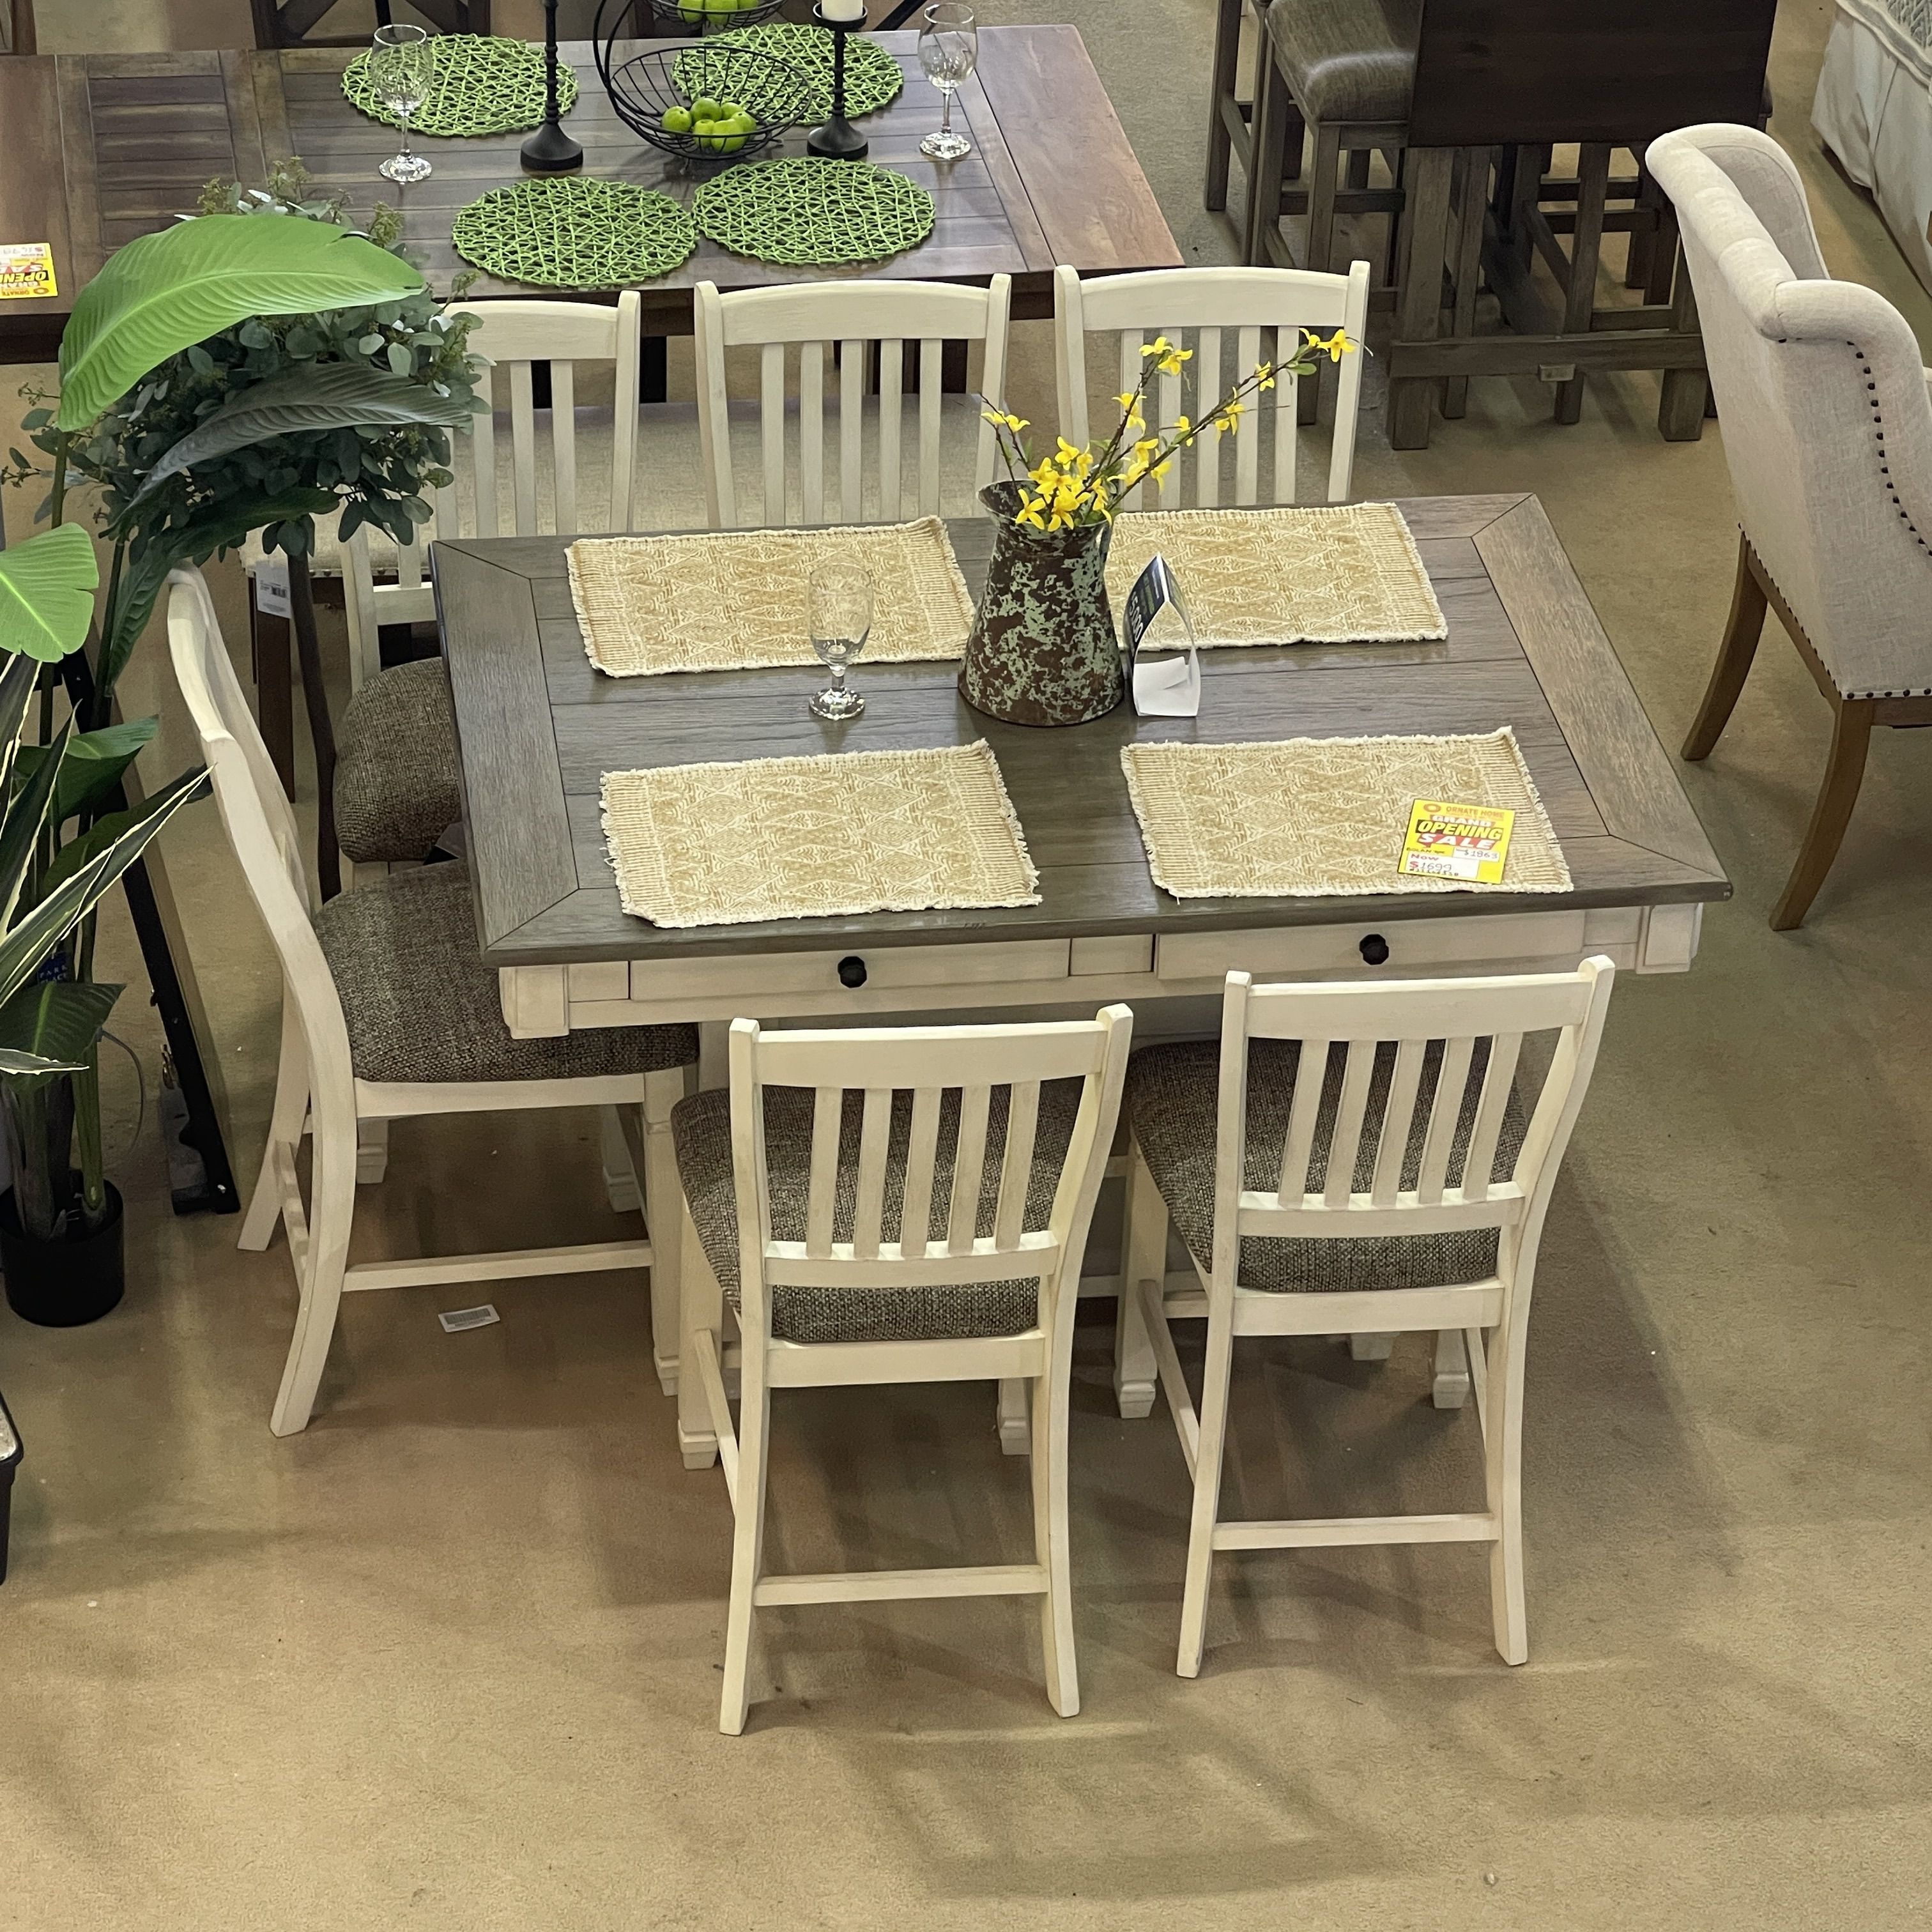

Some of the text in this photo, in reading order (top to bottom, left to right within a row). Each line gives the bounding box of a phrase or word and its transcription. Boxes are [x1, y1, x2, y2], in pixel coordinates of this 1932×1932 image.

[1446, 806, 1478, 815] ORNATE
[1481, 809, 1505, 818] HOME
[1432, 815, 1491, 827] GRAND
[1418, 820, 1503, 840] OPENING
[1418, 833, 1495, 849] SALE
